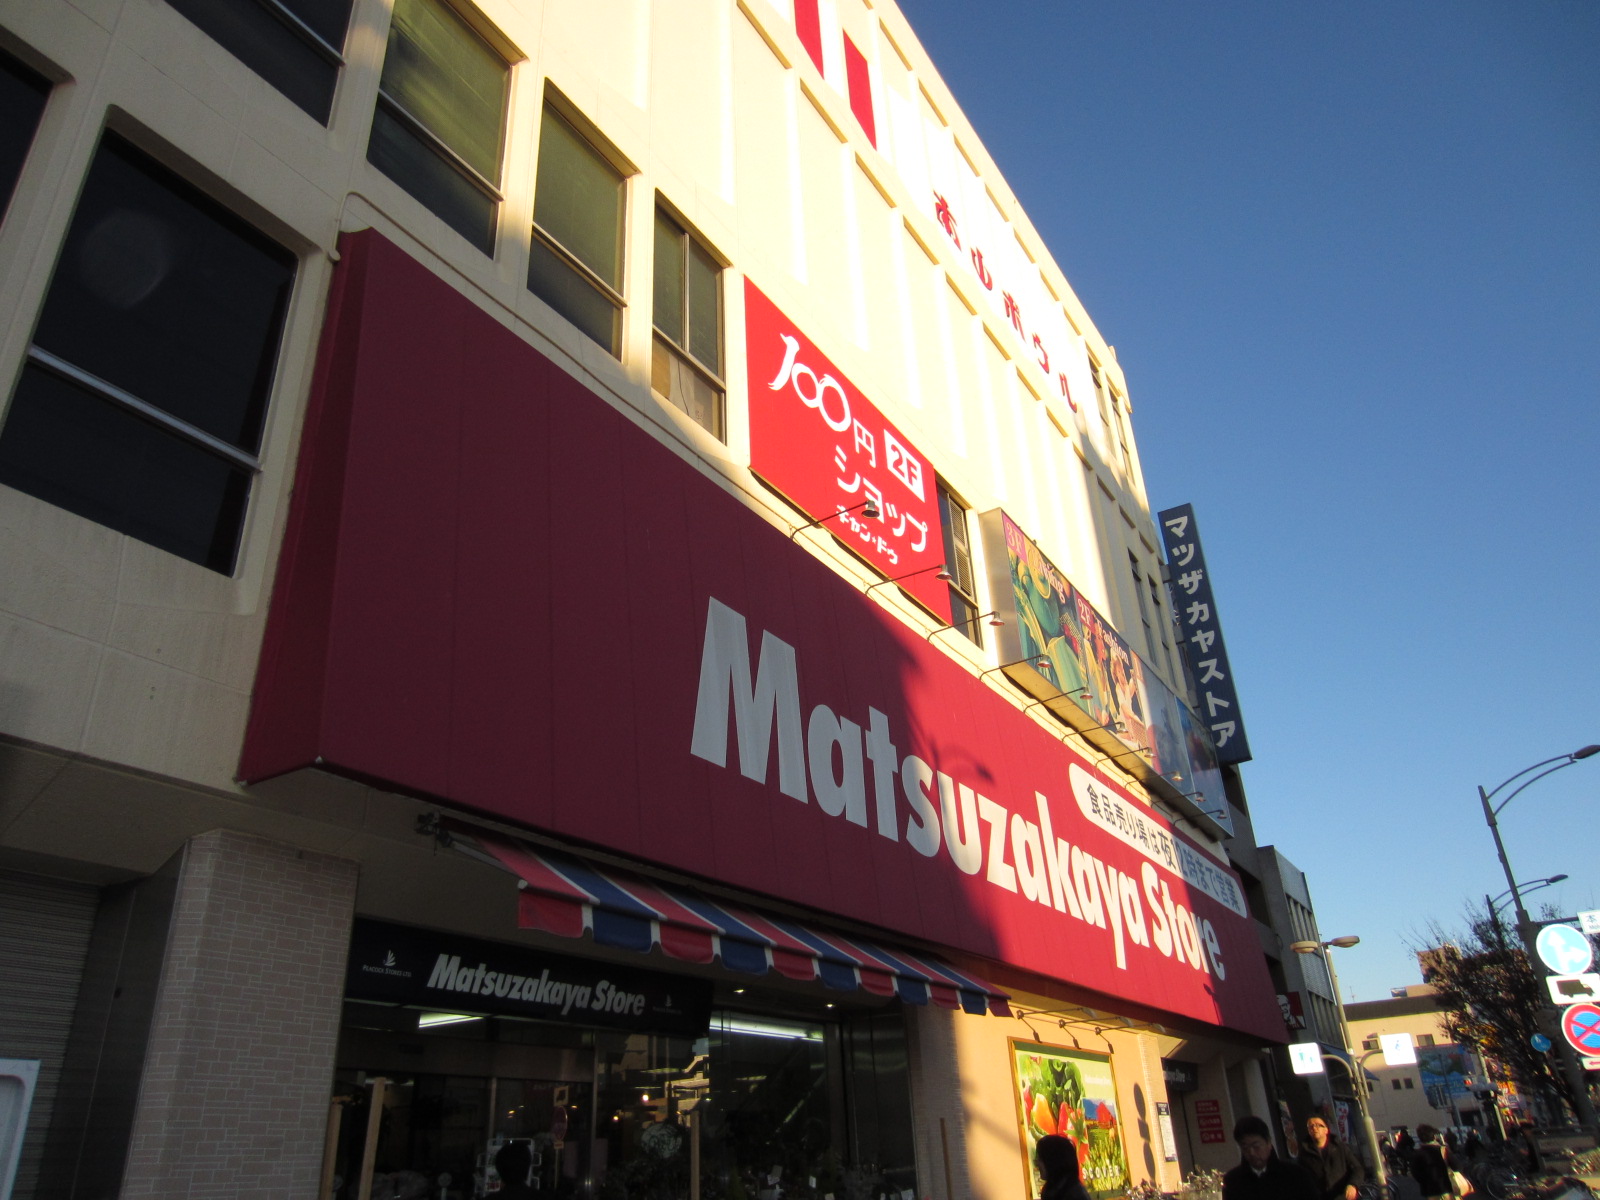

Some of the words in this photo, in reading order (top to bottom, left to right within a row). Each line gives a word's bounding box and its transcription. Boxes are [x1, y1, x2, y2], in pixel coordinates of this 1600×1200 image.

[767, 332, 877, 469] 100円
[834, 444, 929, 553] ショップ
[889, 442, 922, 490] 2F
[1005, 521, 1026, 556] 3F
[1164, 515, 1237, 748] マツザカヤストア
[690, 595, 1149, 970] Matsuzakaya
[1140, 861, 1227, 982] Store
[426, 953, 592, 1016] Matsuzakaya
[593, 979, 646, 1016] Store
